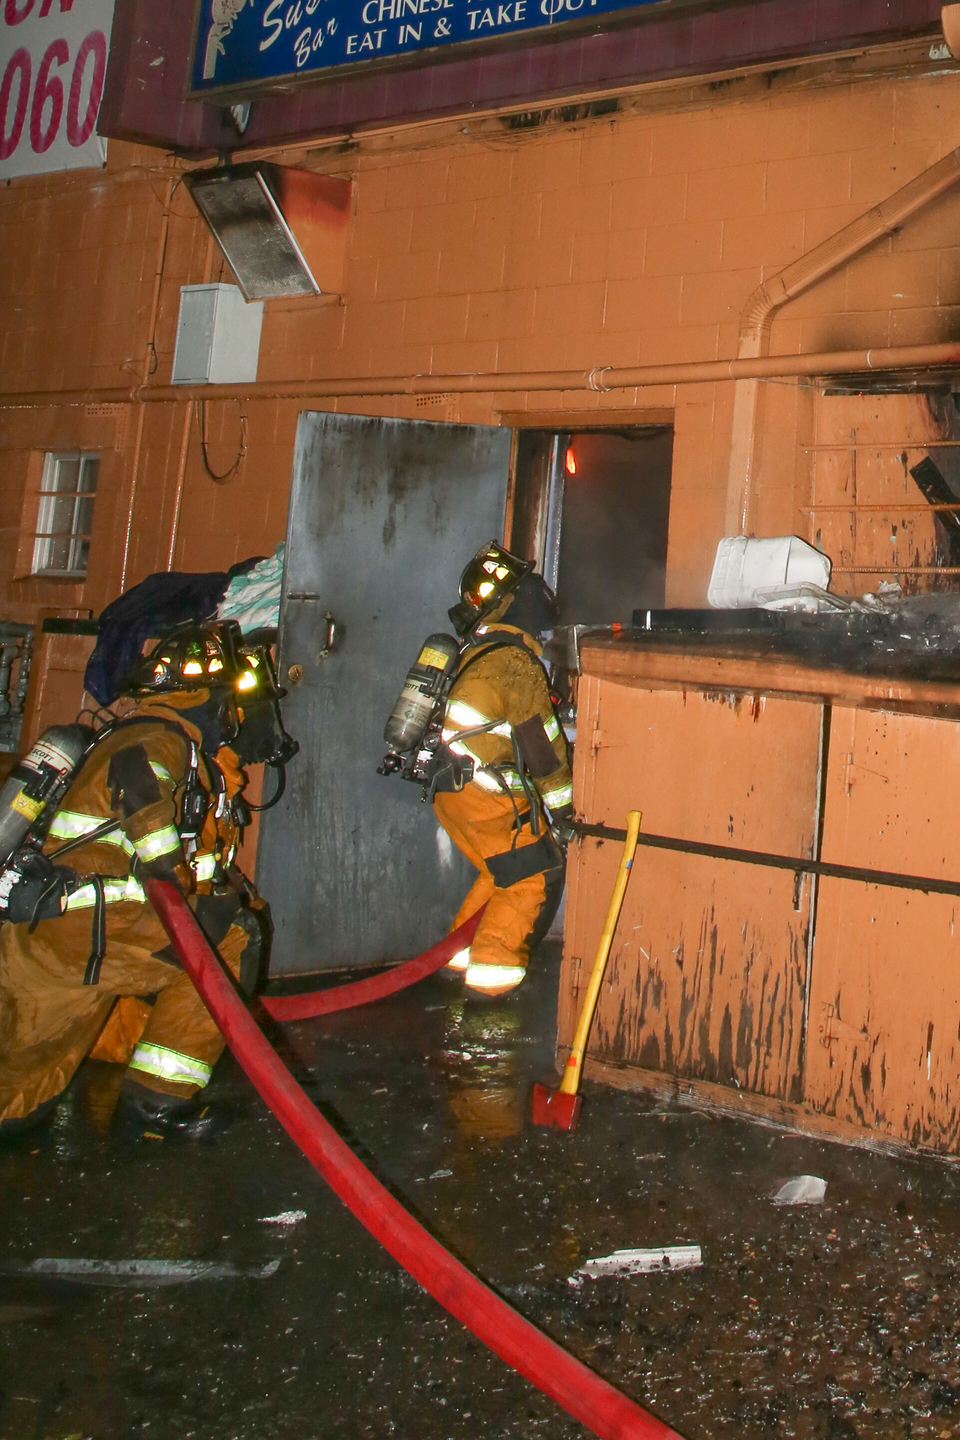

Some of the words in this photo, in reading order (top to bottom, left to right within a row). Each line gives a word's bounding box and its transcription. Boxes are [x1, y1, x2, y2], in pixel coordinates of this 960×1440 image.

[294, 17, 338, 68] Bar
[346, 29, 388, 55] EAT
[398, 21, 423, 45] IN
[433, 17, 452, 39] &
[466, 0, 528, 31] TAKE
[0, 29, 107, 160] 060
